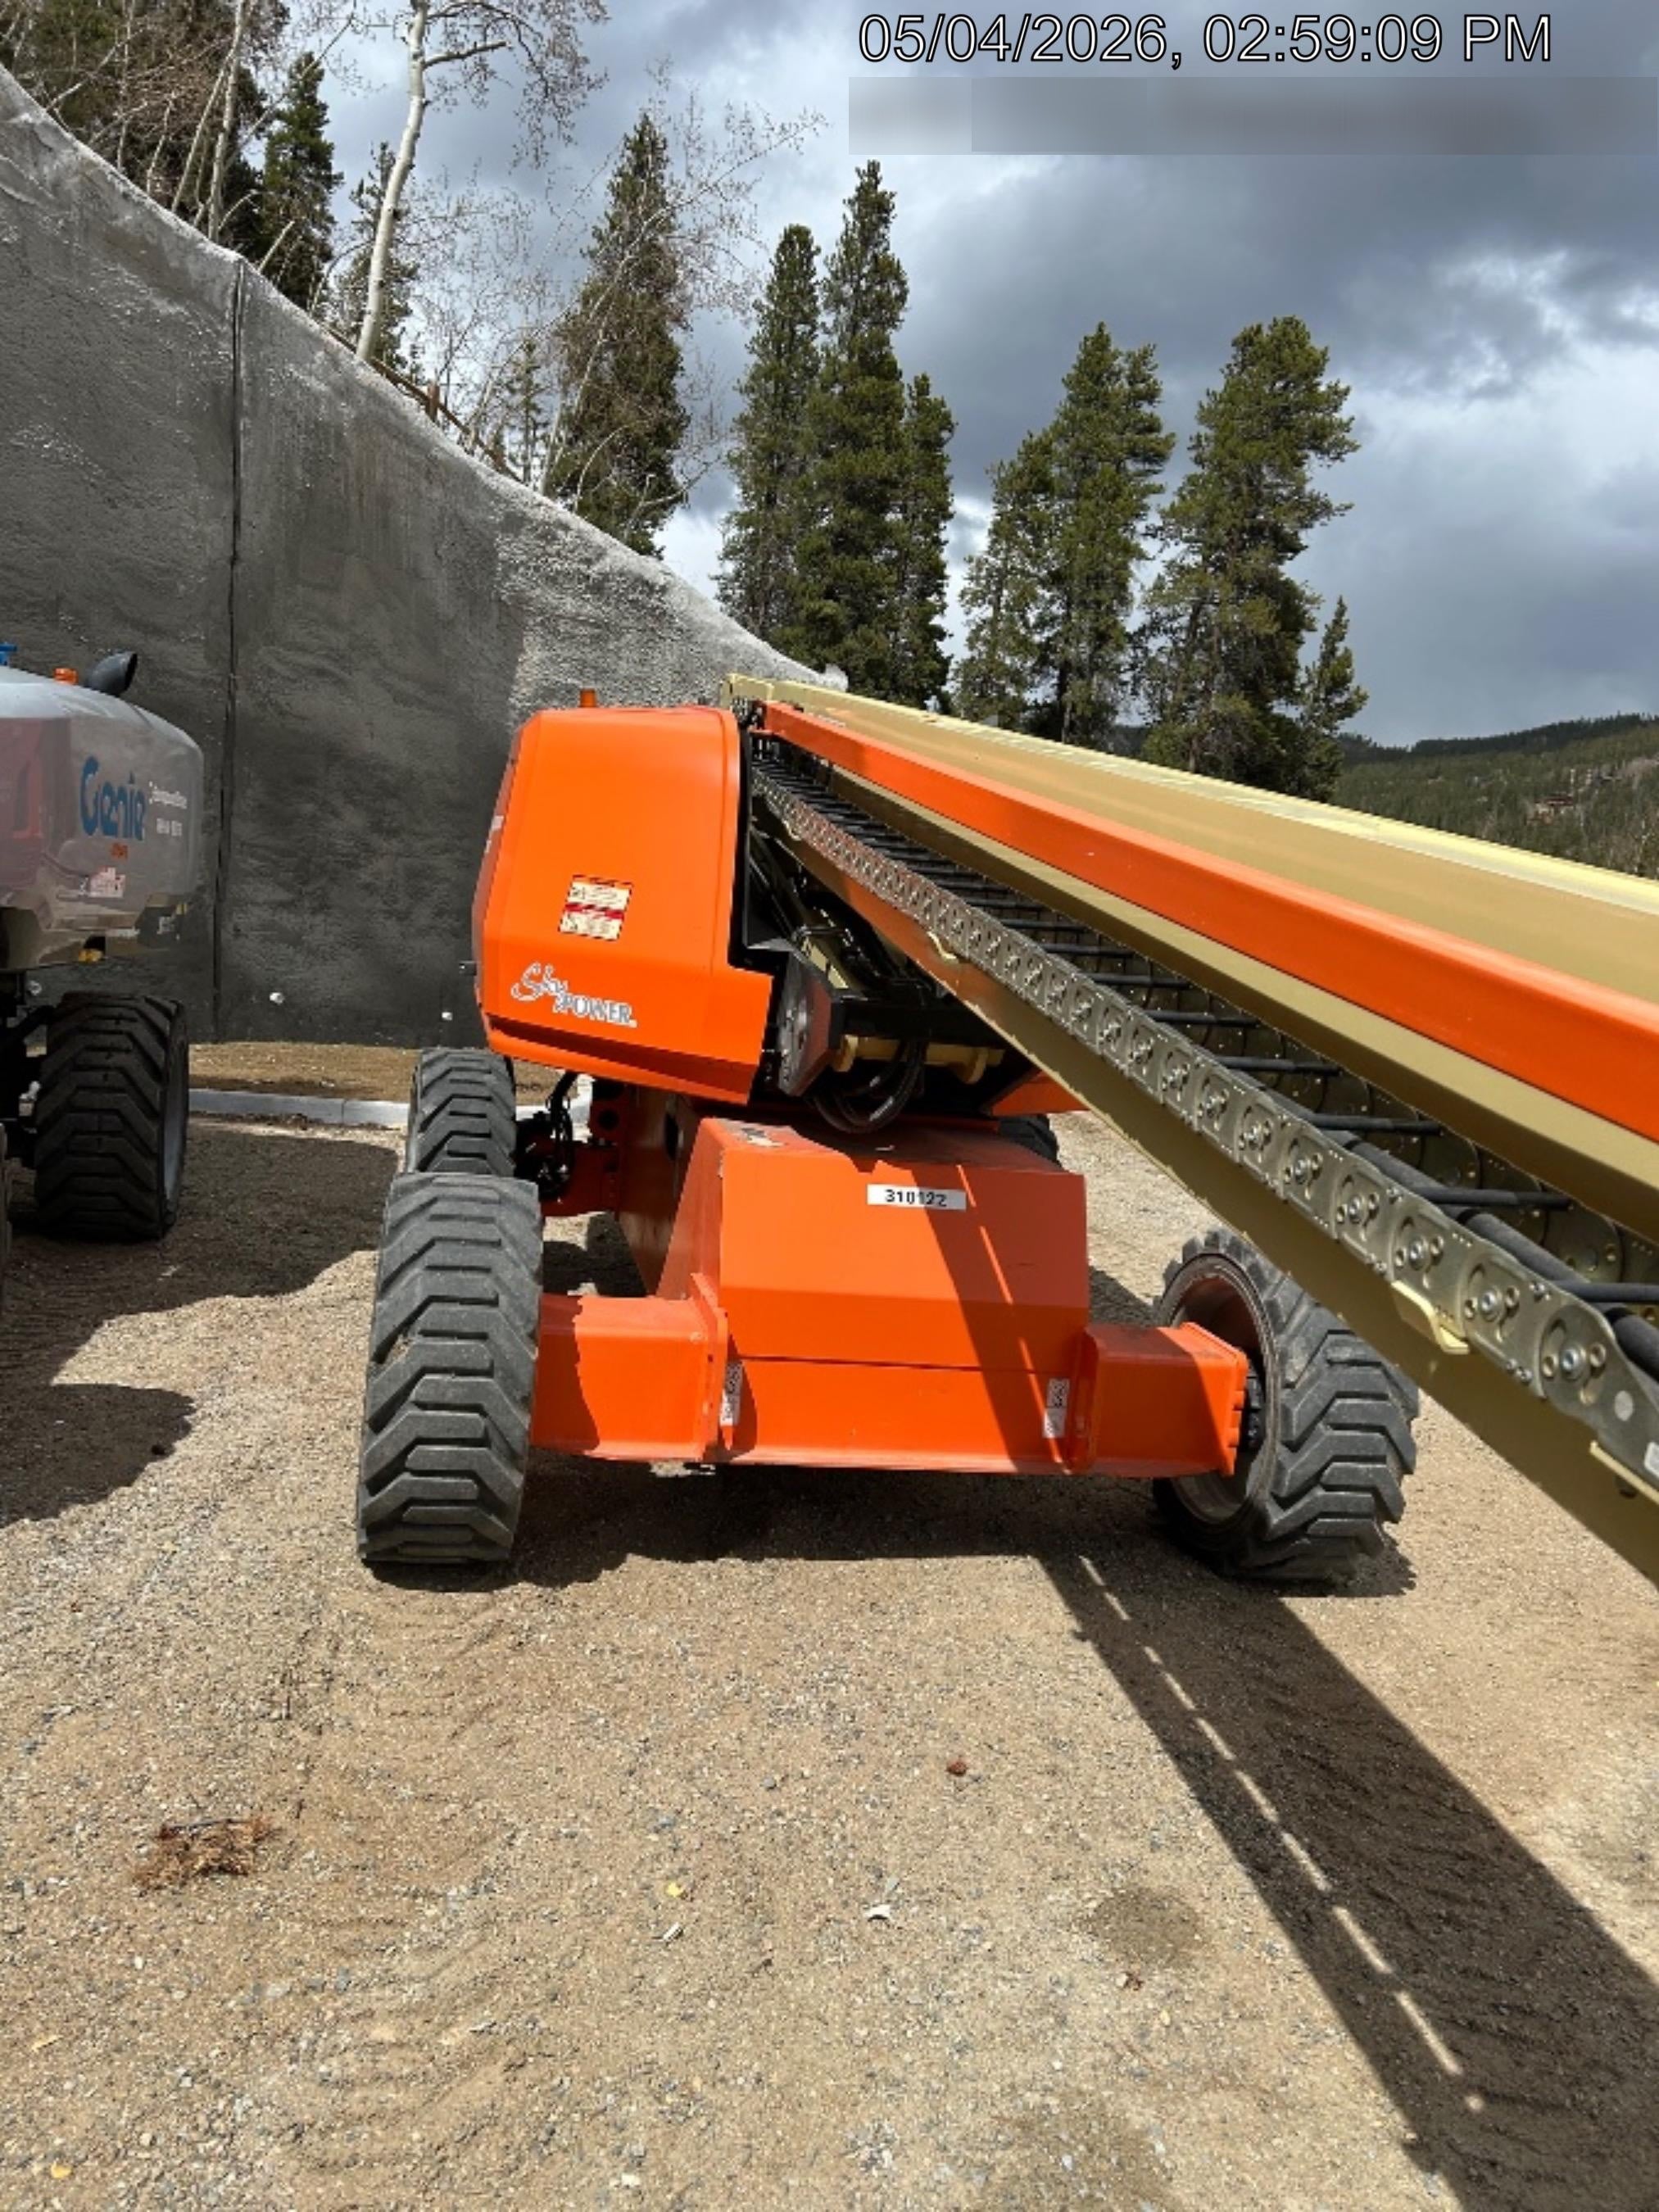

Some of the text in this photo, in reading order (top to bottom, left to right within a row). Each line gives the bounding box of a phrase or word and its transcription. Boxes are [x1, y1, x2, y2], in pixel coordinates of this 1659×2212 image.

[81, 755, 146, 841] Genie
[559, 993, 634, 1027] POWER
[886, 1189, 947, 1207] 310122
